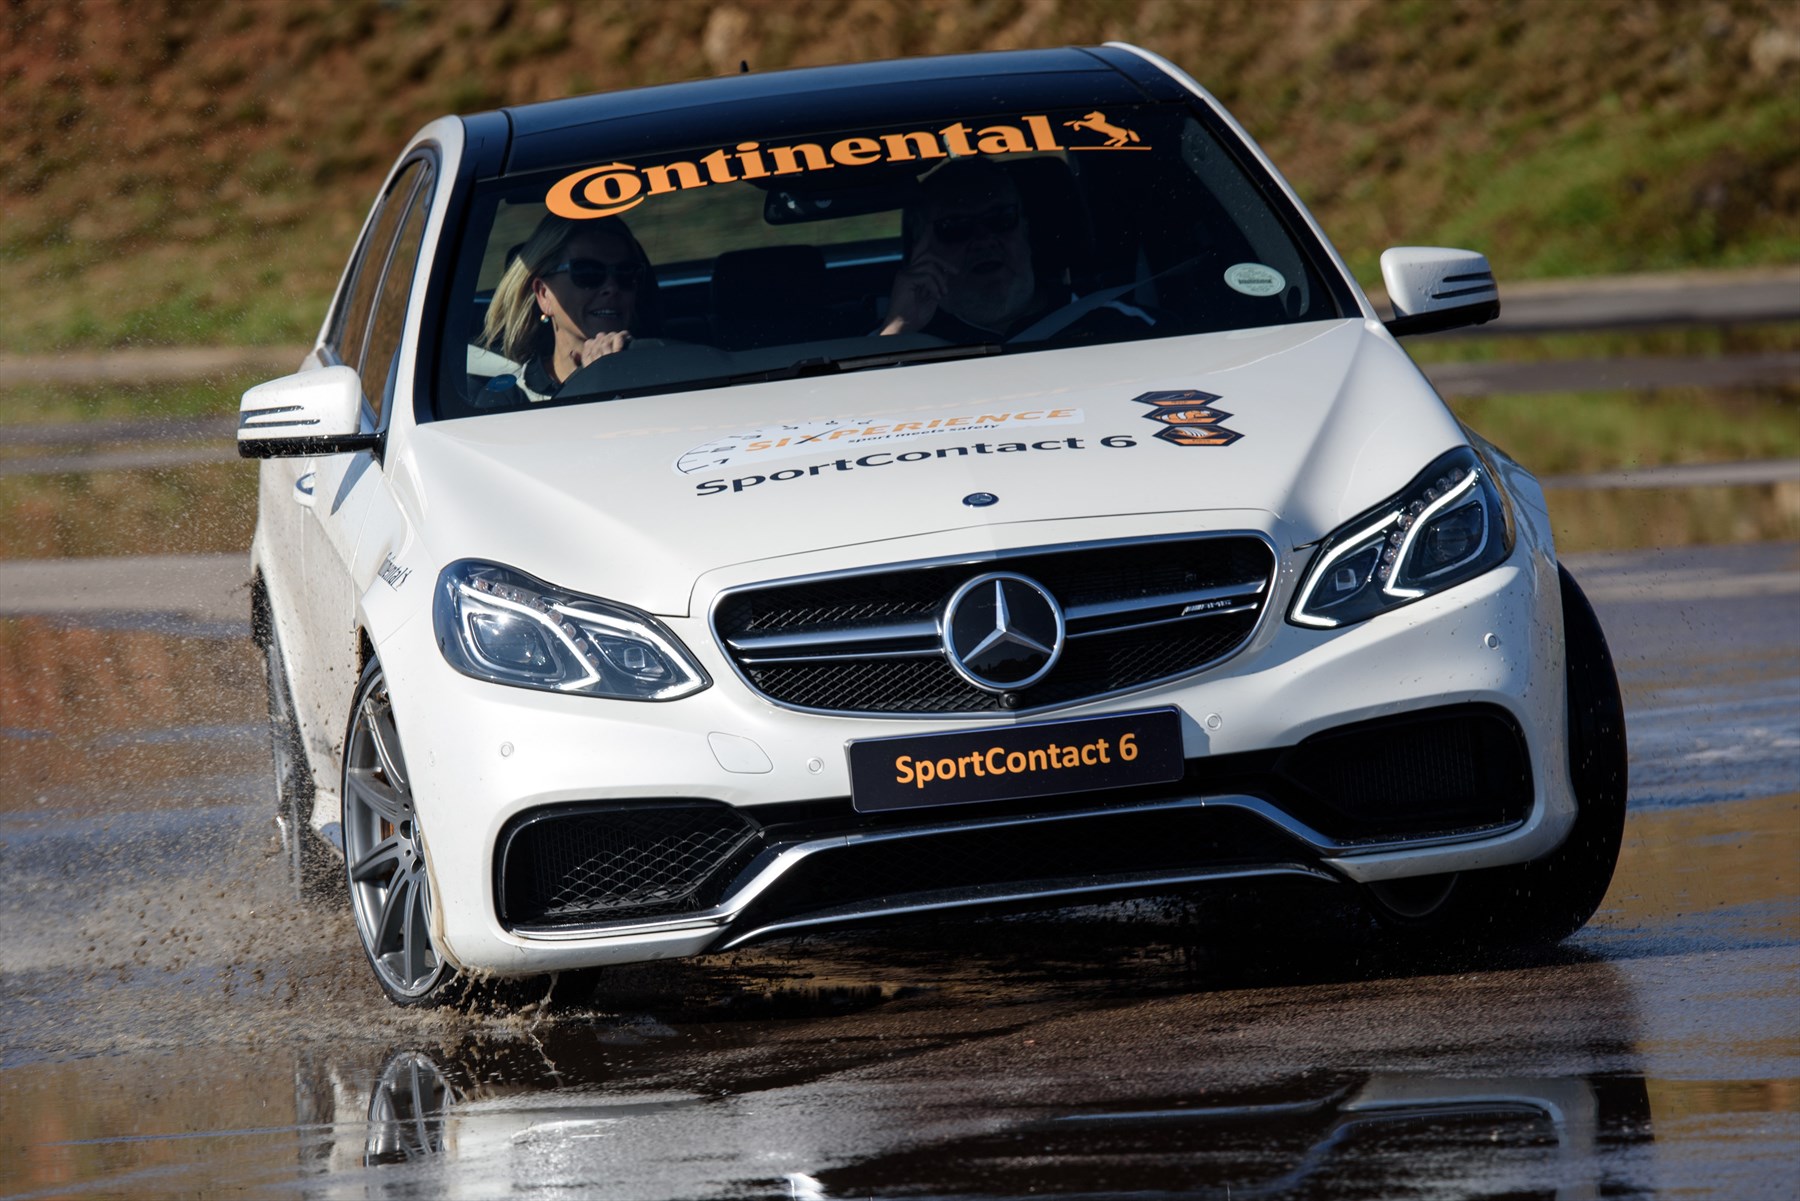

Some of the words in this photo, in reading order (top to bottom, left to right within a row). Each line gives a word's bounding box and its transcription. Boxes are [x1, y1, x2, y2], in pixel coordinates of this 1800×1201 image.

[545, 115, 1064, 220] Continental
[746, 409, 1076, 451] SIXPERIENCE
[848, 434, 890, 443] sport
[696, 437, 1085, 495] SportContact
[1099, 434, 1137, 448] 6
[895, 738, 1111, 789] SportContact
[1119, 733, 1138, 761] 6
